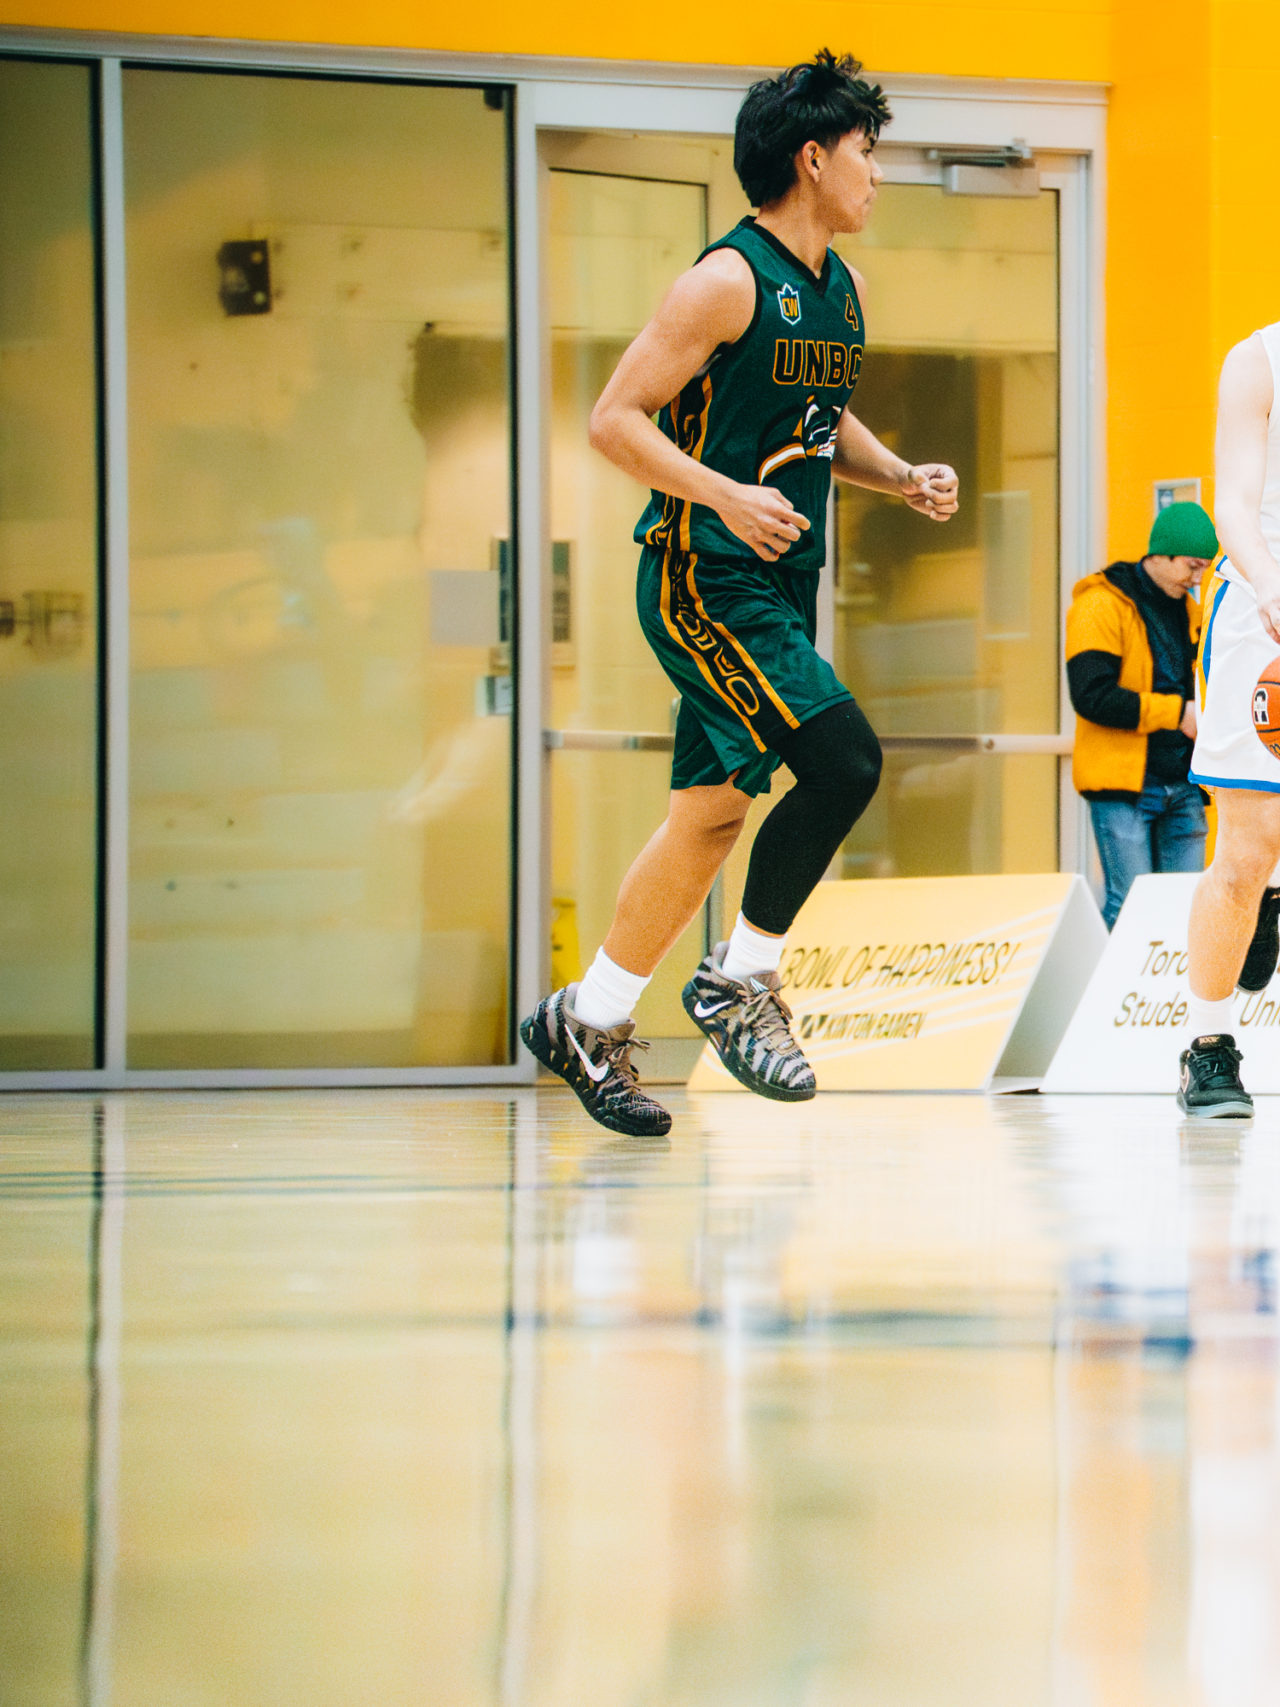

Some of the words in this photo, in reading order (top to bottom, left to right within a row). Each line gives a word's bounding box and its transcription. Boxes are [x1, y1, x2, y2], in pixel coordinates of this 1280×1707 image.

[781, 298, 798, 317] CW
[844, 293, 859, 331] 4
[772, 338, 864, 389] UNBC
[781, 947, 848, 988] BOWL
[842, 945, 886, 988] OF
[870, 941, 1021, 987] HAPPINESS!
[1140, 940, 1188, 976] Toro
